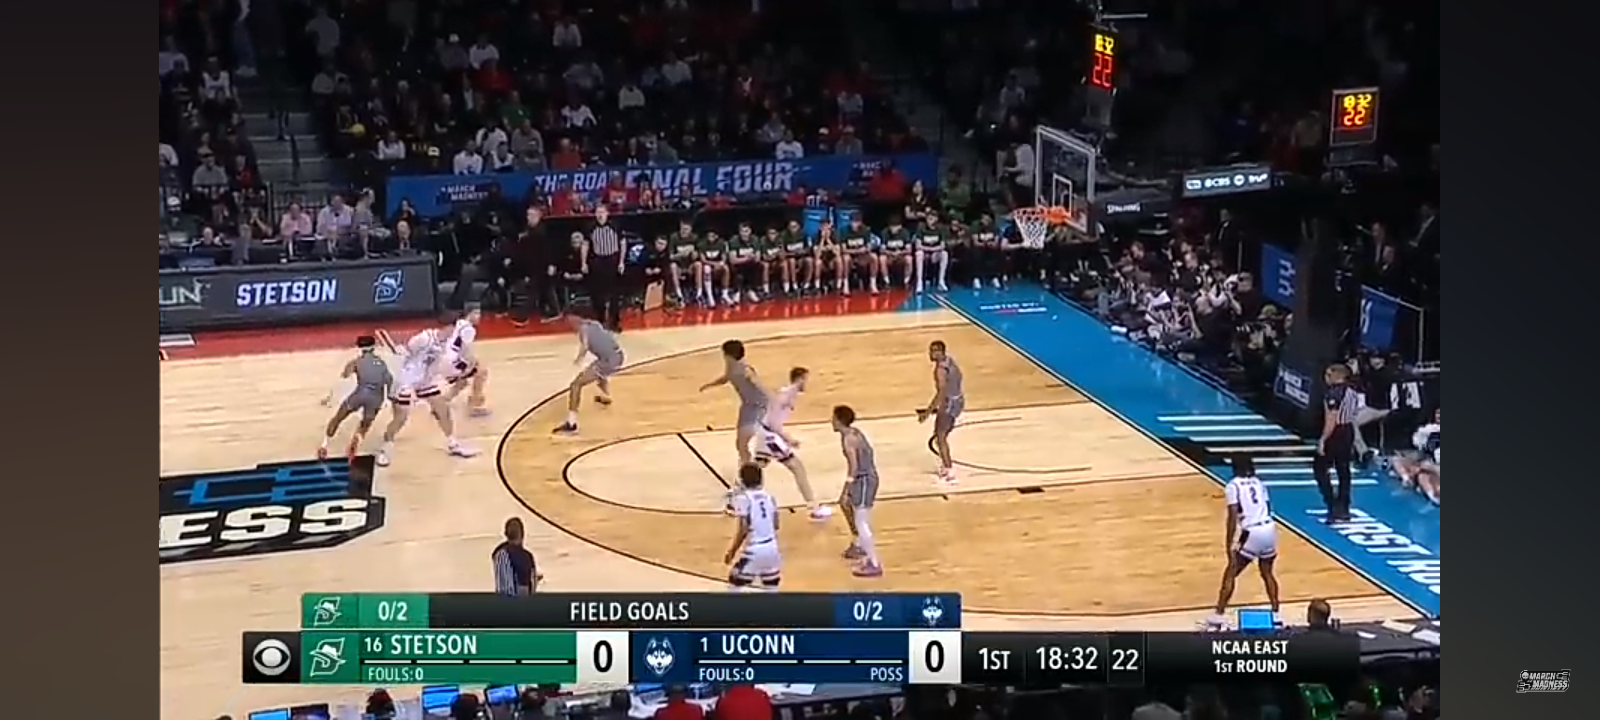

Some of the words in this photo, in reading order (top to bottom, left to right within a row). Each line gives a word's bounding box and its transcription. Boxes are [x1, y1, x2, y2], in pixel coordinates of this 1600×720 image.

[1093, 52, 1112, 87] 22
[1343, 106, 1366, 125] 22
[716, 162, 793, 193] FOUR
[236, 278, 337, 307] STETSON
